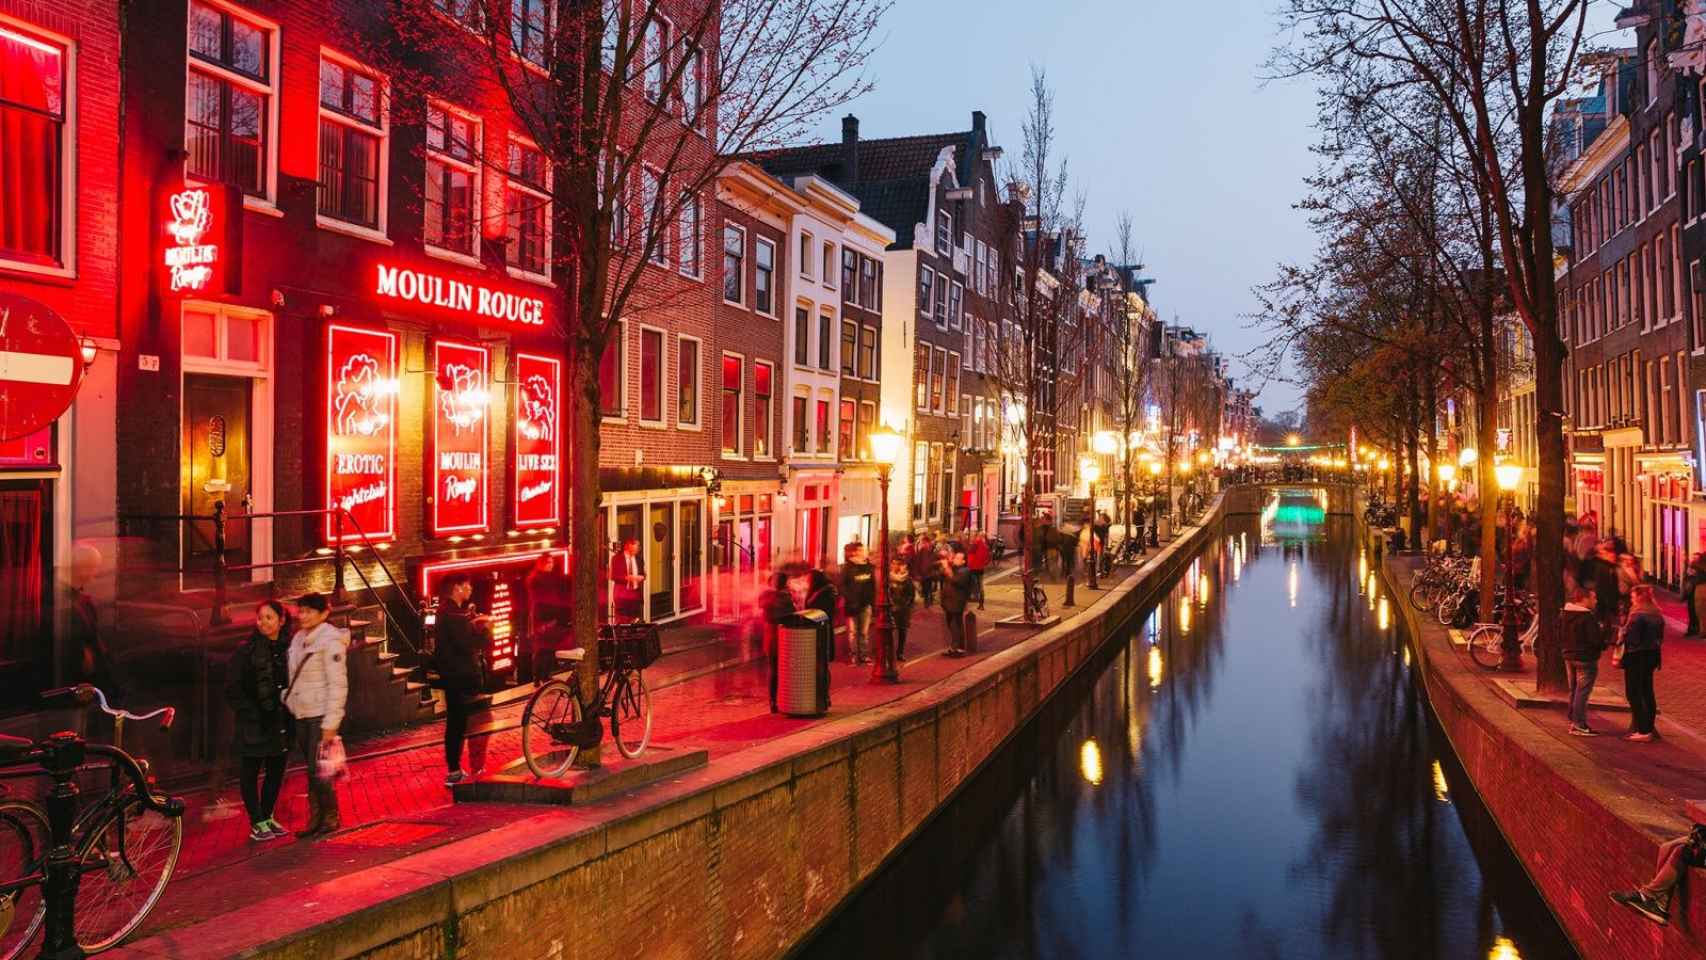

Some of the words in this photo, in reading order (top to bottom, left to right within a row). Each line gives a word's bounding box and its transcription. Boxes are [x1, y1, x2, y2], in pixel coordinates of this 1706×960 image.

[376, 263, 473, 312] MOULIN
[477, 287, 545, 325] ROUGE
[336, 453, 384, 474] EROTIC
[440, 451, 481, 470] MOULIN
[518, 454, 539, 471] LIVE
